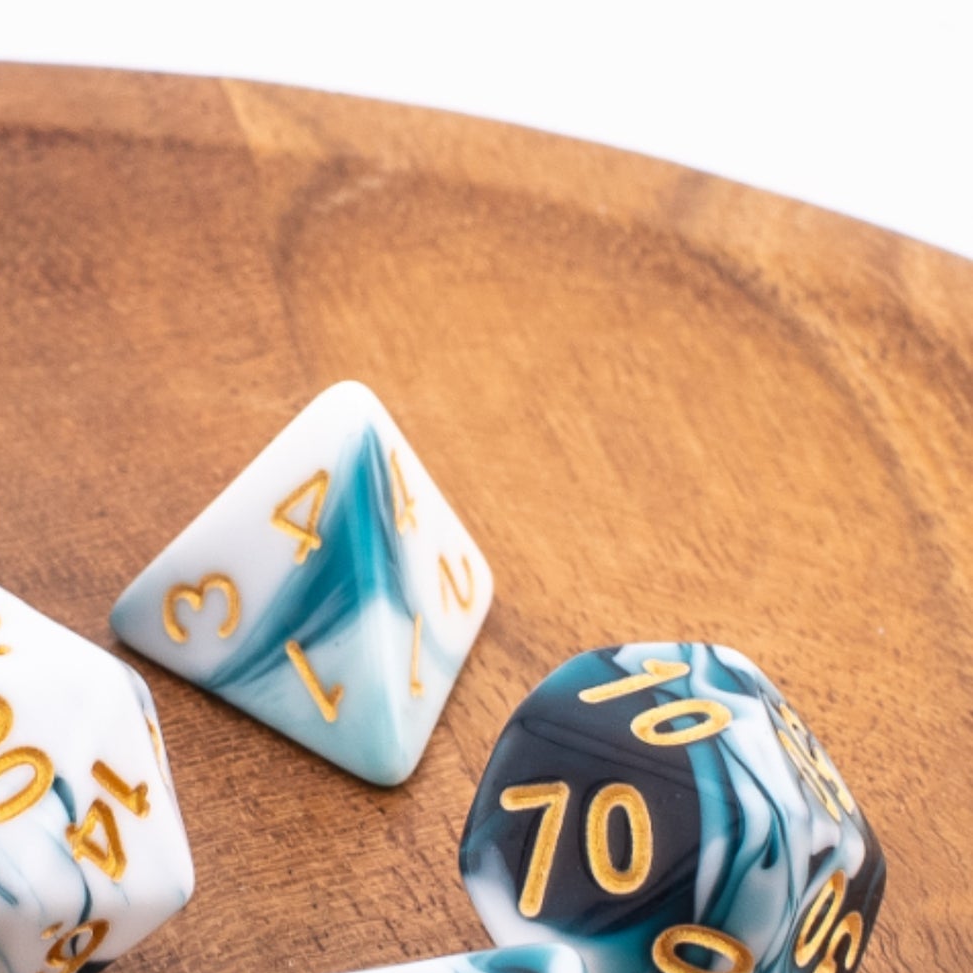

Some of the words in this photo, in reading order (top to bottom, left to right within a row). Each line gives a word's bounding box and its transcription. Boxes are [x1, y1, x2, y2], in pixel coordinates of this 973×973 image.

[270, 469, 331, 565] 4
[162, 572, 242, 643] 3
[437, 552, 475, 613] 2
[285, 640, 344, 722] 1
[578, 659, 732, 746] 10
[66, 760, 151, 881] 14
[499, 780, 654, 918] 70
